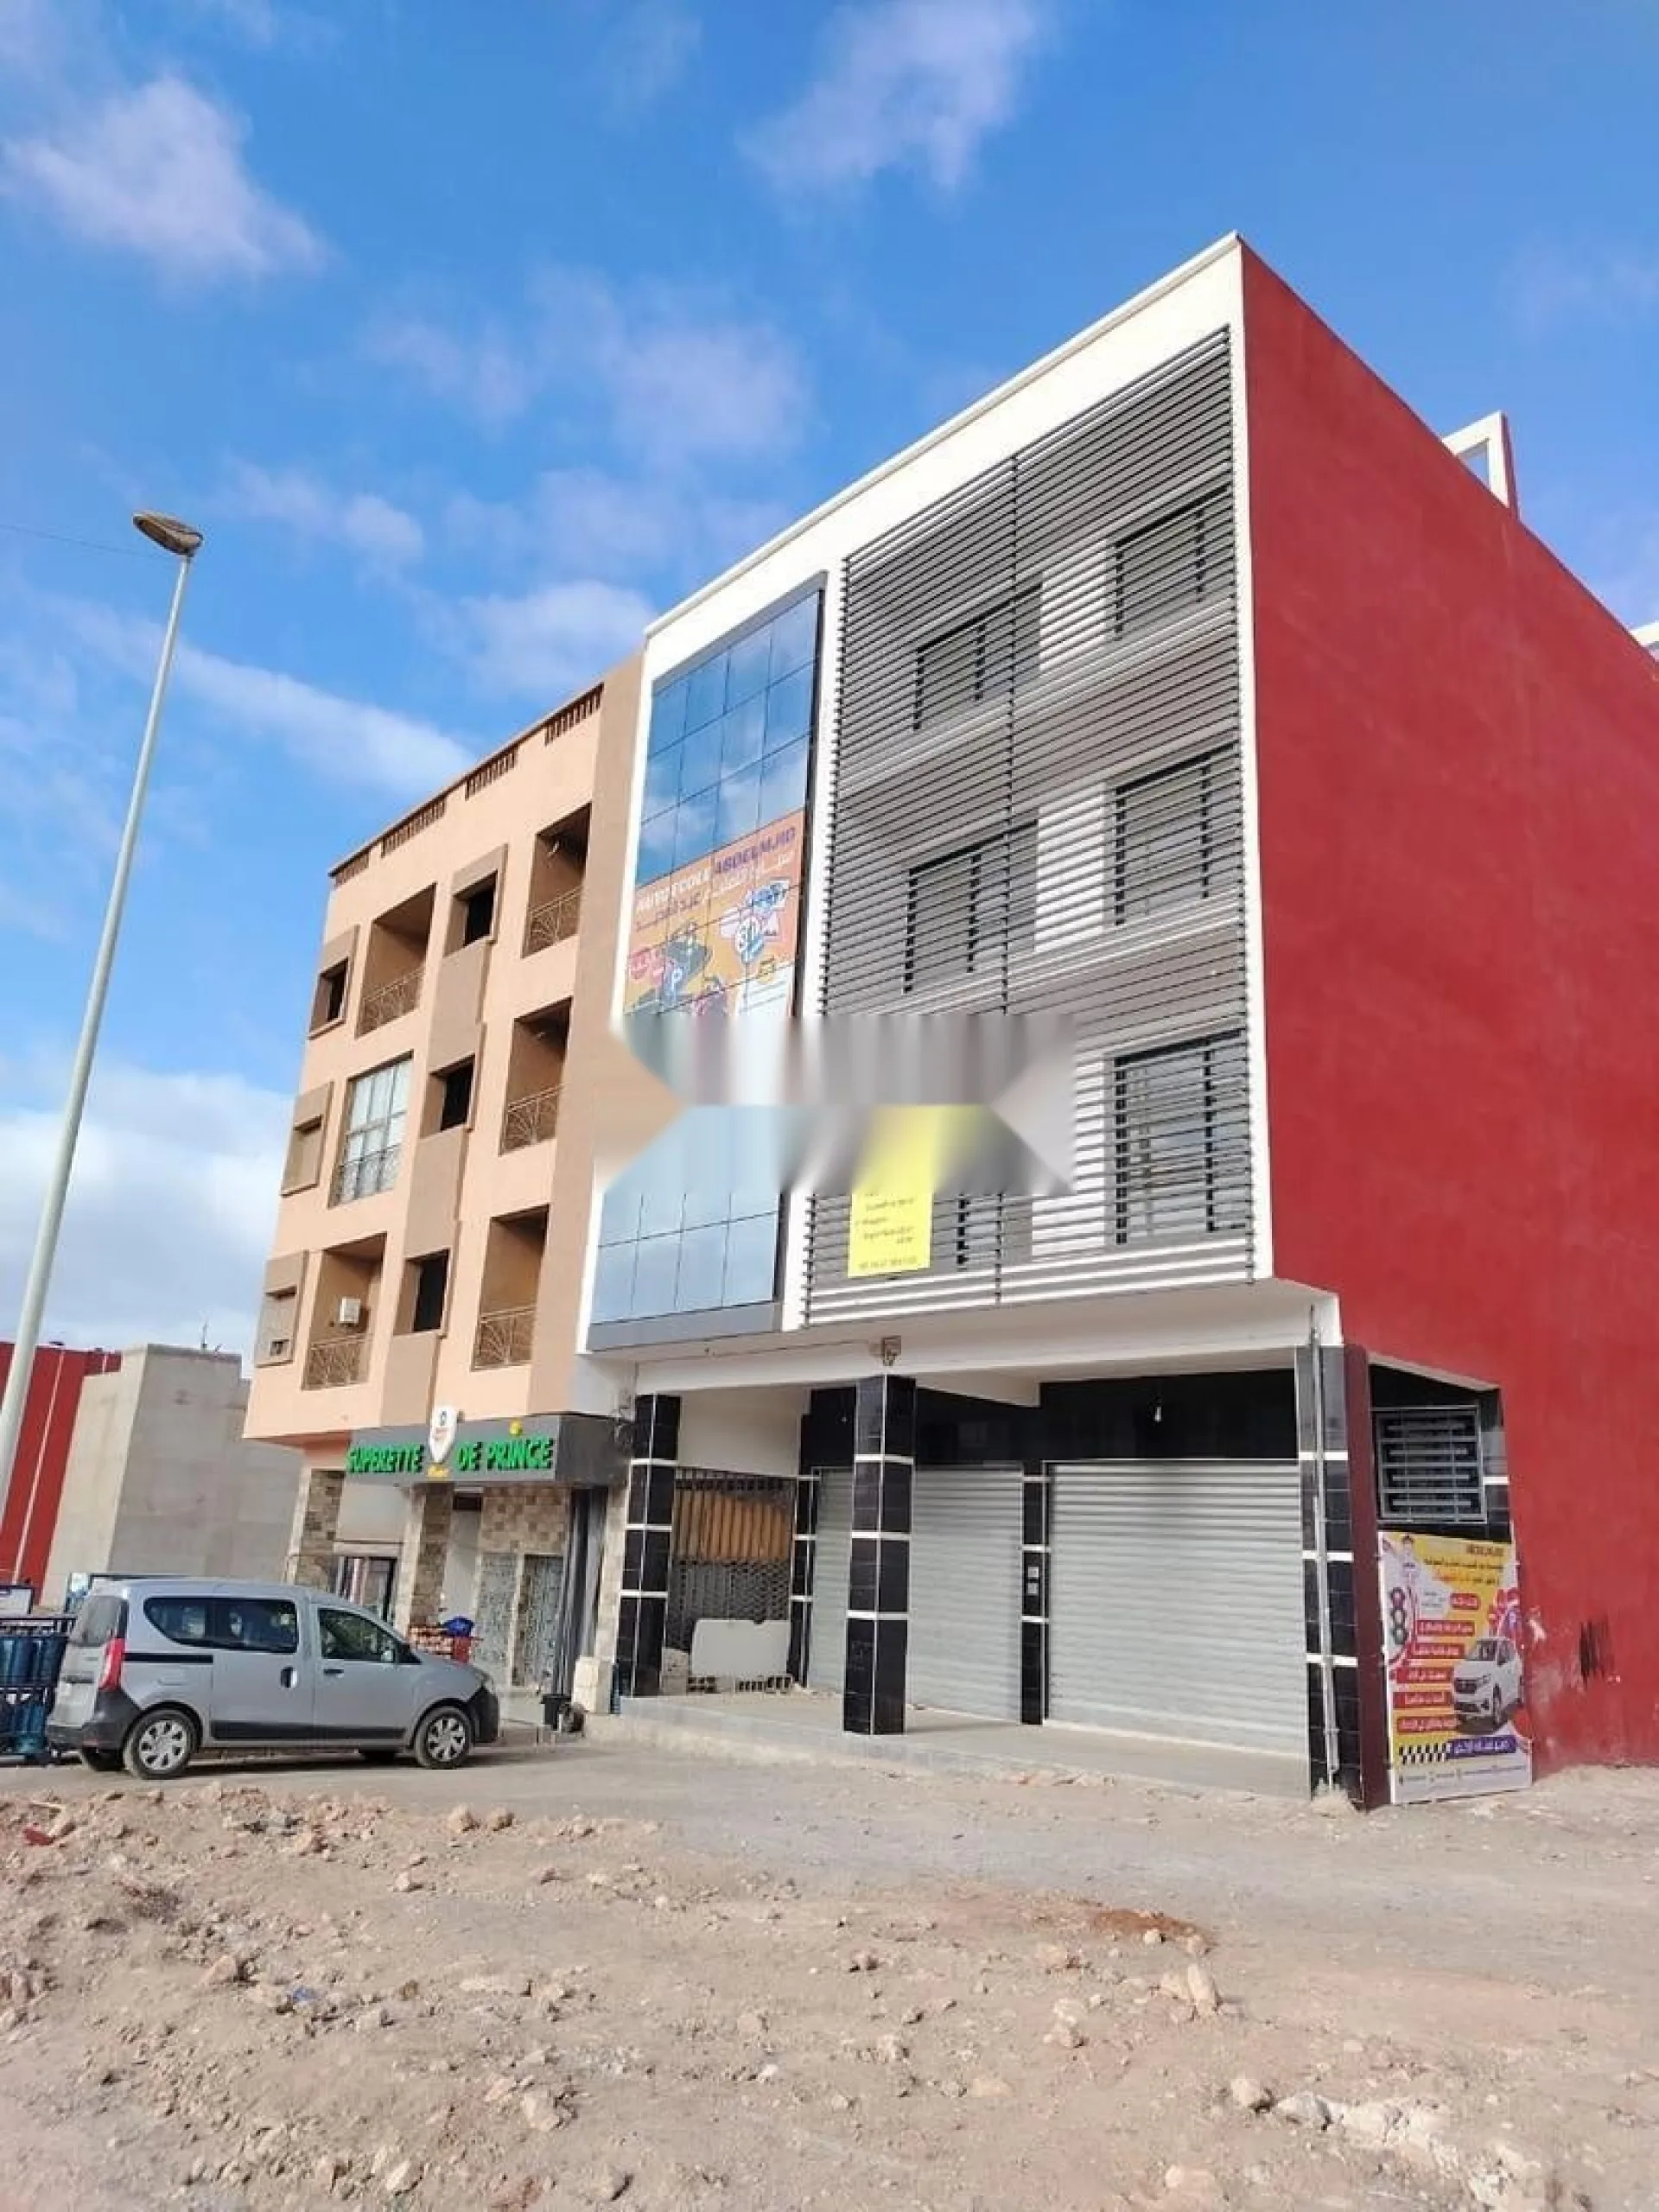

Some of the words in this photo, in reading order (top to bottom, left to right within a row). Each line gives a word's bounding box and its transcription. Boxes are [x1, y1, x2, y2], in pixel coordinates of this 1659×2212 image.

[347, 1444, 424, 1473] SUPERETTE
[455, 1440, 483, 1471] DE
[486, 1435, 555, 1471] PRINCE
